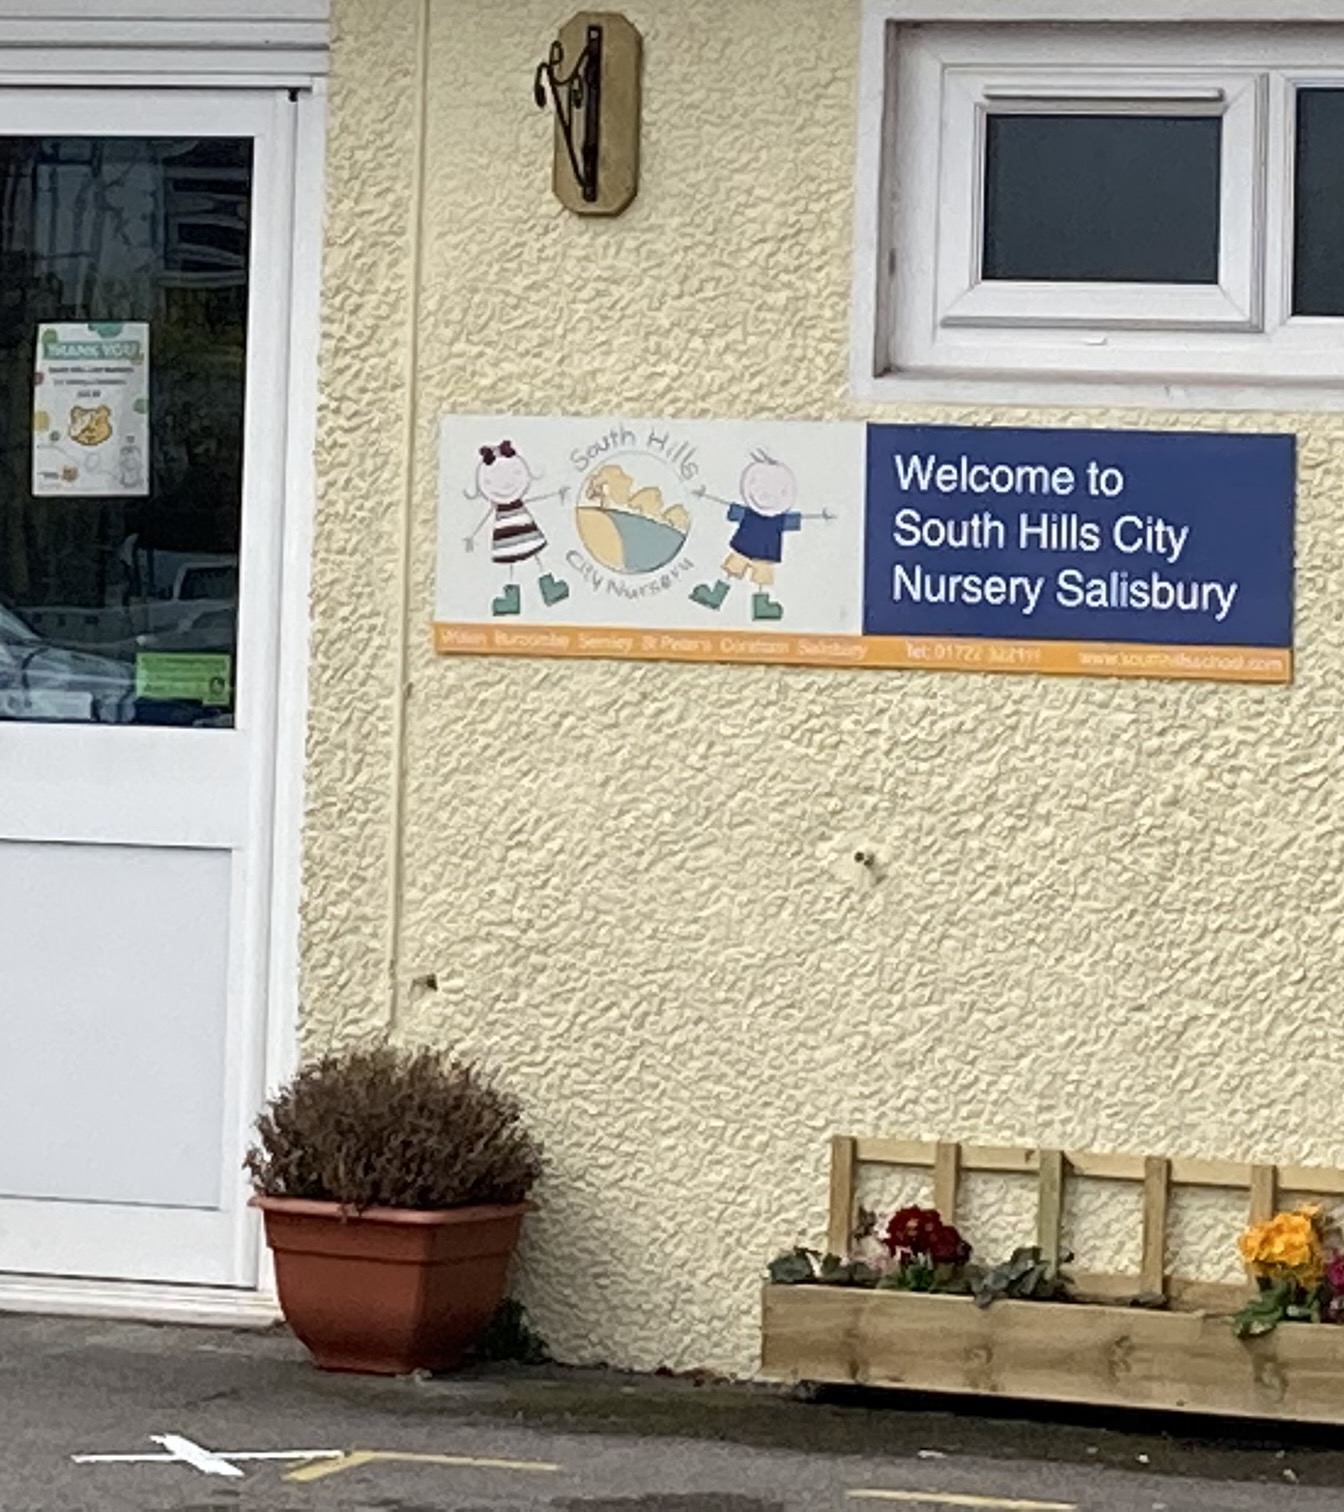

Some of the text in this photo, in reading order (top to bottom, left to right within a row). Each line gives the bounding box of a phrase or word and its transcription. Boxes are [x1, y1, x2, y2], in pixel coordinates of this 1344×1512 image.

[569, 423, 700, 480] South Hills
[894, 453, 1124, 497] Welcome to
[893, 508, 1189, 564] South Hills City
[565, 549, 695, 600] City Nursery
[892, 564, 1239, 622] Nursery Salisbury
[934, 643, 983, 662] 01722
